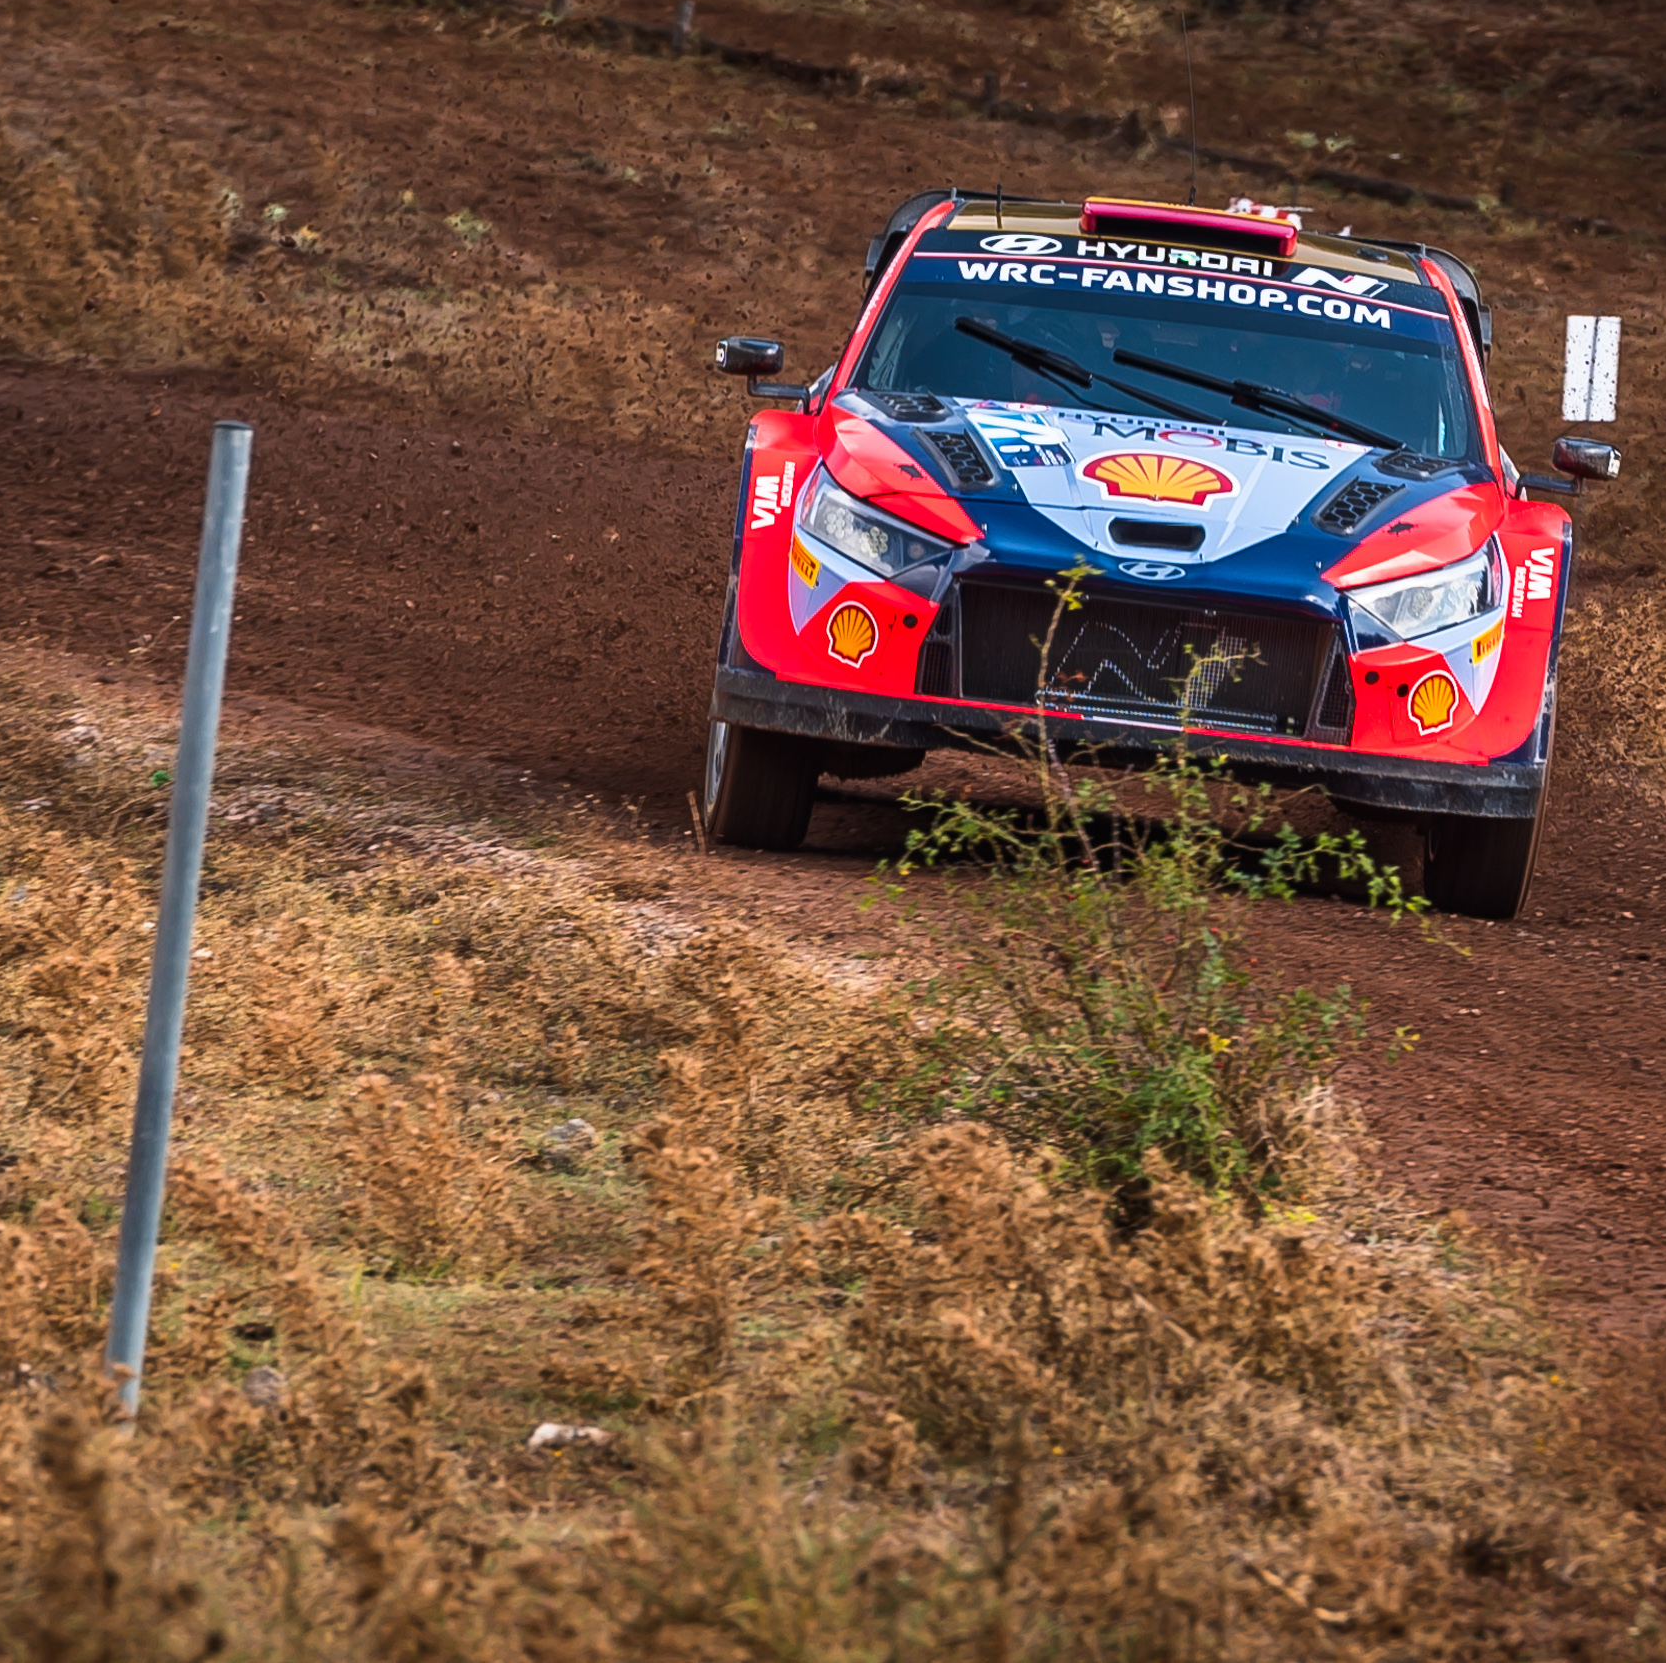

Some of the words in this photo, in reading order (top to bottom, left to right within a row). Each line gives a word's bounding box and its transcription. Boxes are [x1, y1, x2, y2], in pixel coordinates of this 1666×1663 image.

[1077, 239, 1273, 278] HYUNDAI
[958, 260, 1392, 330] WRC-FANSHOP.COM
[1093, 421, 1331, 471] MOBIS
